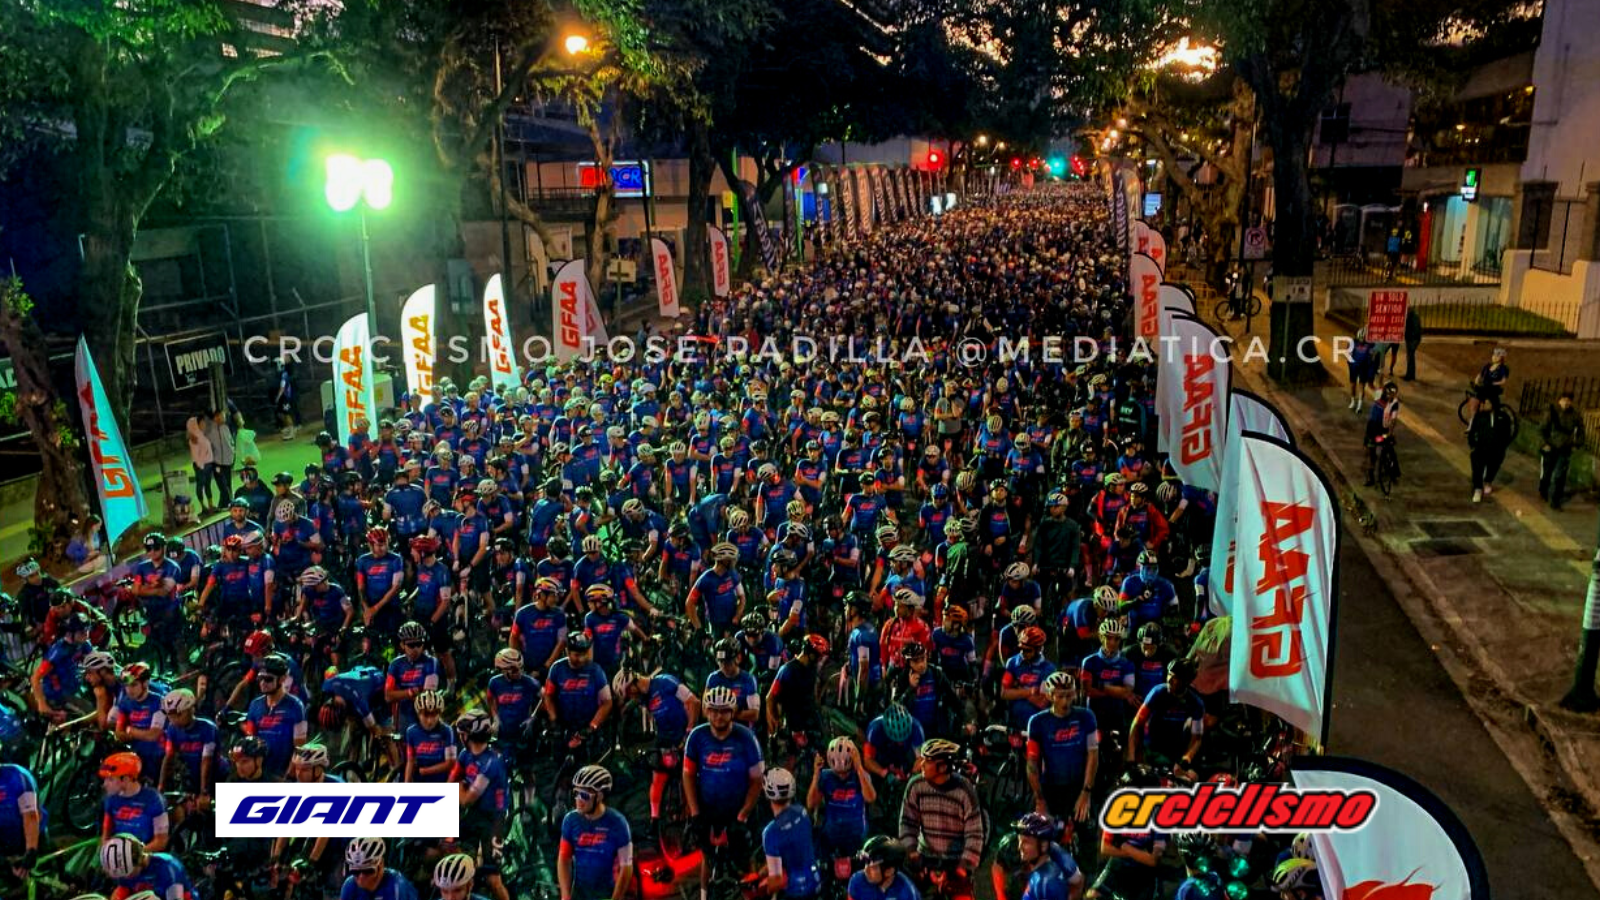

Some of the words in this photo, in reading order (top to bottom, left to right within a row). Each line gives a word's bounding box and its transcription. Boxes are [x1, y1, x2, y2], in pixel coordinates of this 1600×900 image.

[488, 299, 512, 374] GFAA
[559, 281, 580, 349] GFAA
[175, 345, 226, 375] PRIVADO
[408, 314, 433, 395] GFAA
